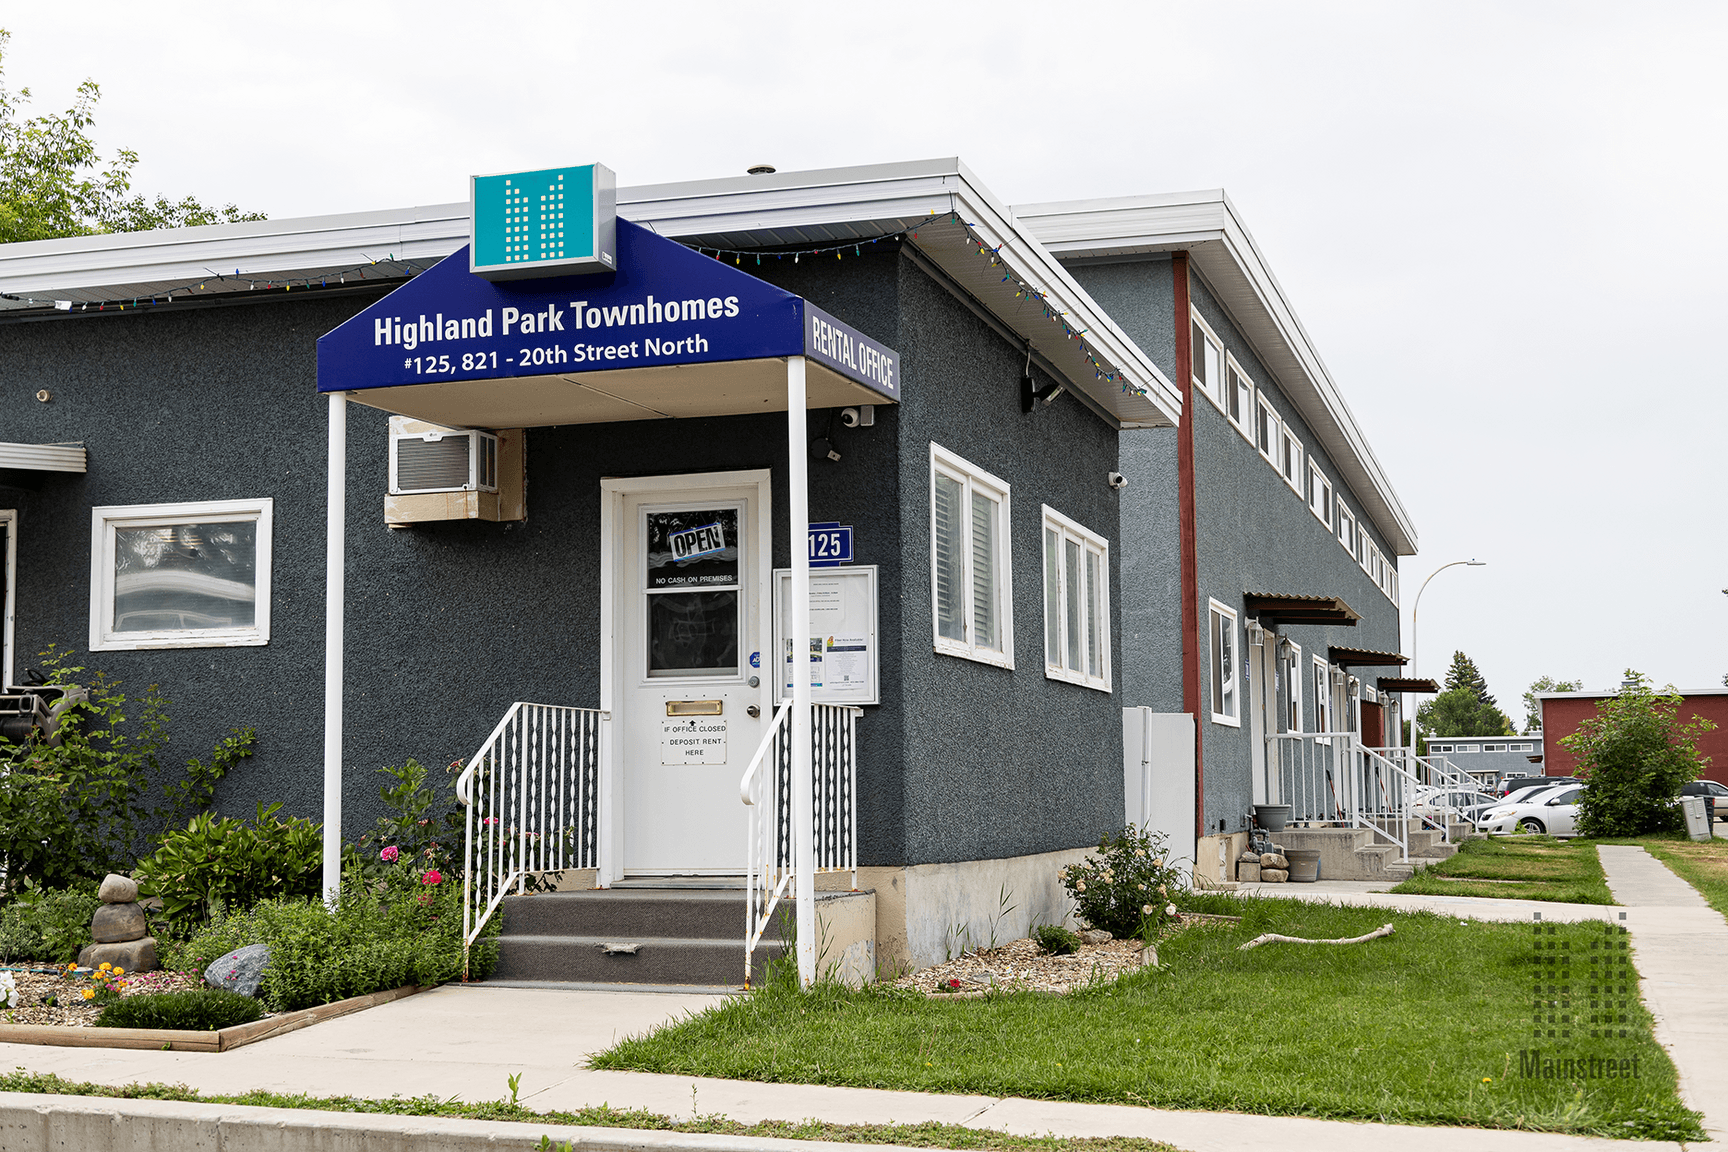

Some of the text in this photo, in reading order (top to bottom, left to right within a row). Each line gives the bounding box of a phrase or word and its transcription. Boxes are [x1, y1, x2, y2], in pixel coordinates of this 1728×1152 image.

[374, 295, 740, 351] Highland Park Townhomes
[404, 355, 457, 375] #125,
[461, 351, 498, 371] 821
[519, 344, 568, 367] 20th
[573, 340, 639, 363] Street
[644, 333, 709, 356] North
[812, 315, 894, 390] RENTAL OFFICE
[673, 525, 722, 558] OPEN
[808, 533, 841, 557] 125
[699, 574, 733, 582] PREMISES
[672, 725, 697, 733] OFFICE
